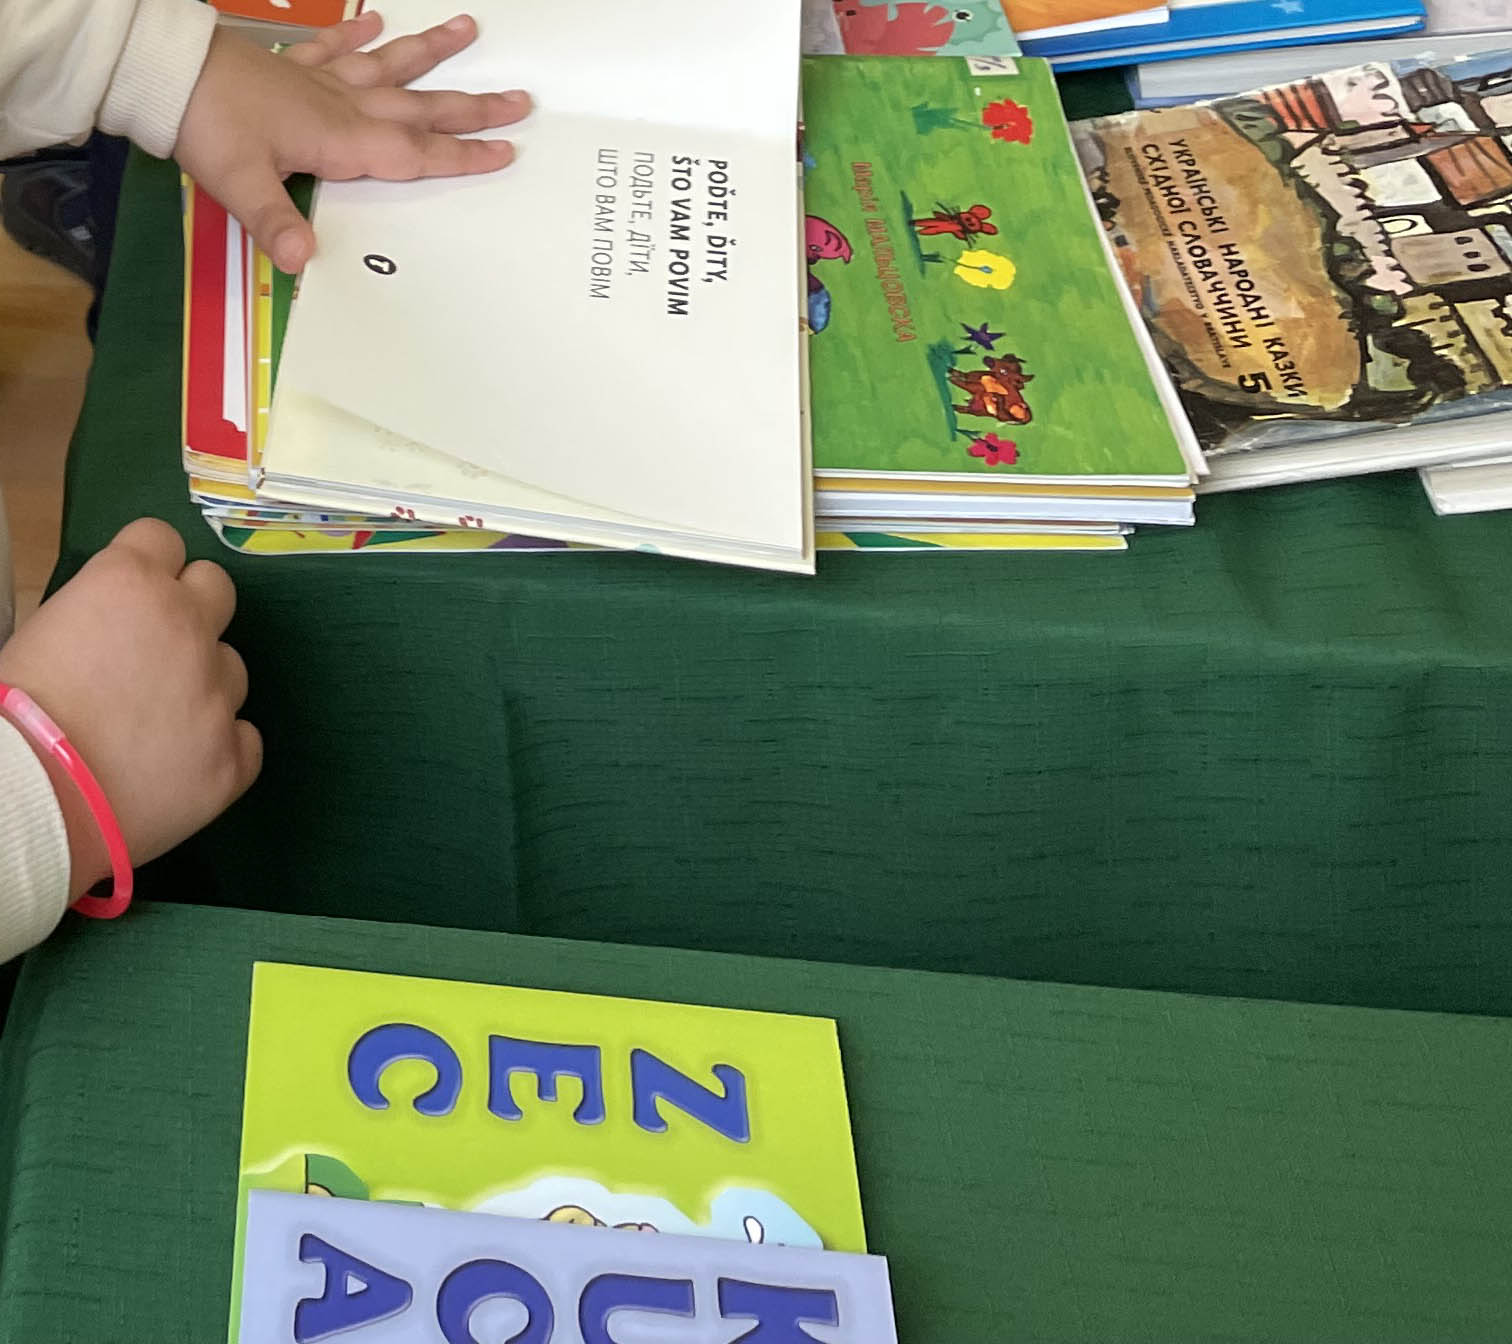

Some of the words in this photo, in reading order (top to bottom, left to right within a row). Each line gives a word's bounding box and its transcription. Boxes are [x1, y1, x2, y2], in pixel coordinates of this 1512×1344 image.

[596, 148, 618, 187] ШТО
[628, 151, 654, 224] ПОДЬТЕ,
[671, 155, 700, 191] ŠTO
[702, 159, 736, 227] POĎTE,
[593, 194, 615, 232] ВАМ
[670, 197, 690, 241] VAM
[589, 238, 612, 298] ПОВІМ
[625, 230, 654, 276] ДЇТИ,
[701, 235, 736, 284] ĎITY,
[1140, 142, 1195, 216] СХІДНОЇ
[1178, 219, 1252, 350] СЛОВАЧЧИНИ
[1238, 371, 1272, 395] 5
[1168, 137, 1229, 235] УКРАЇНСЬКІ
[1218, 241, 1275, 330] НАРОДНІ
[1262, 334, 1308, 400] КАЗКИ
[667, 248, 688, 315] POVIM
